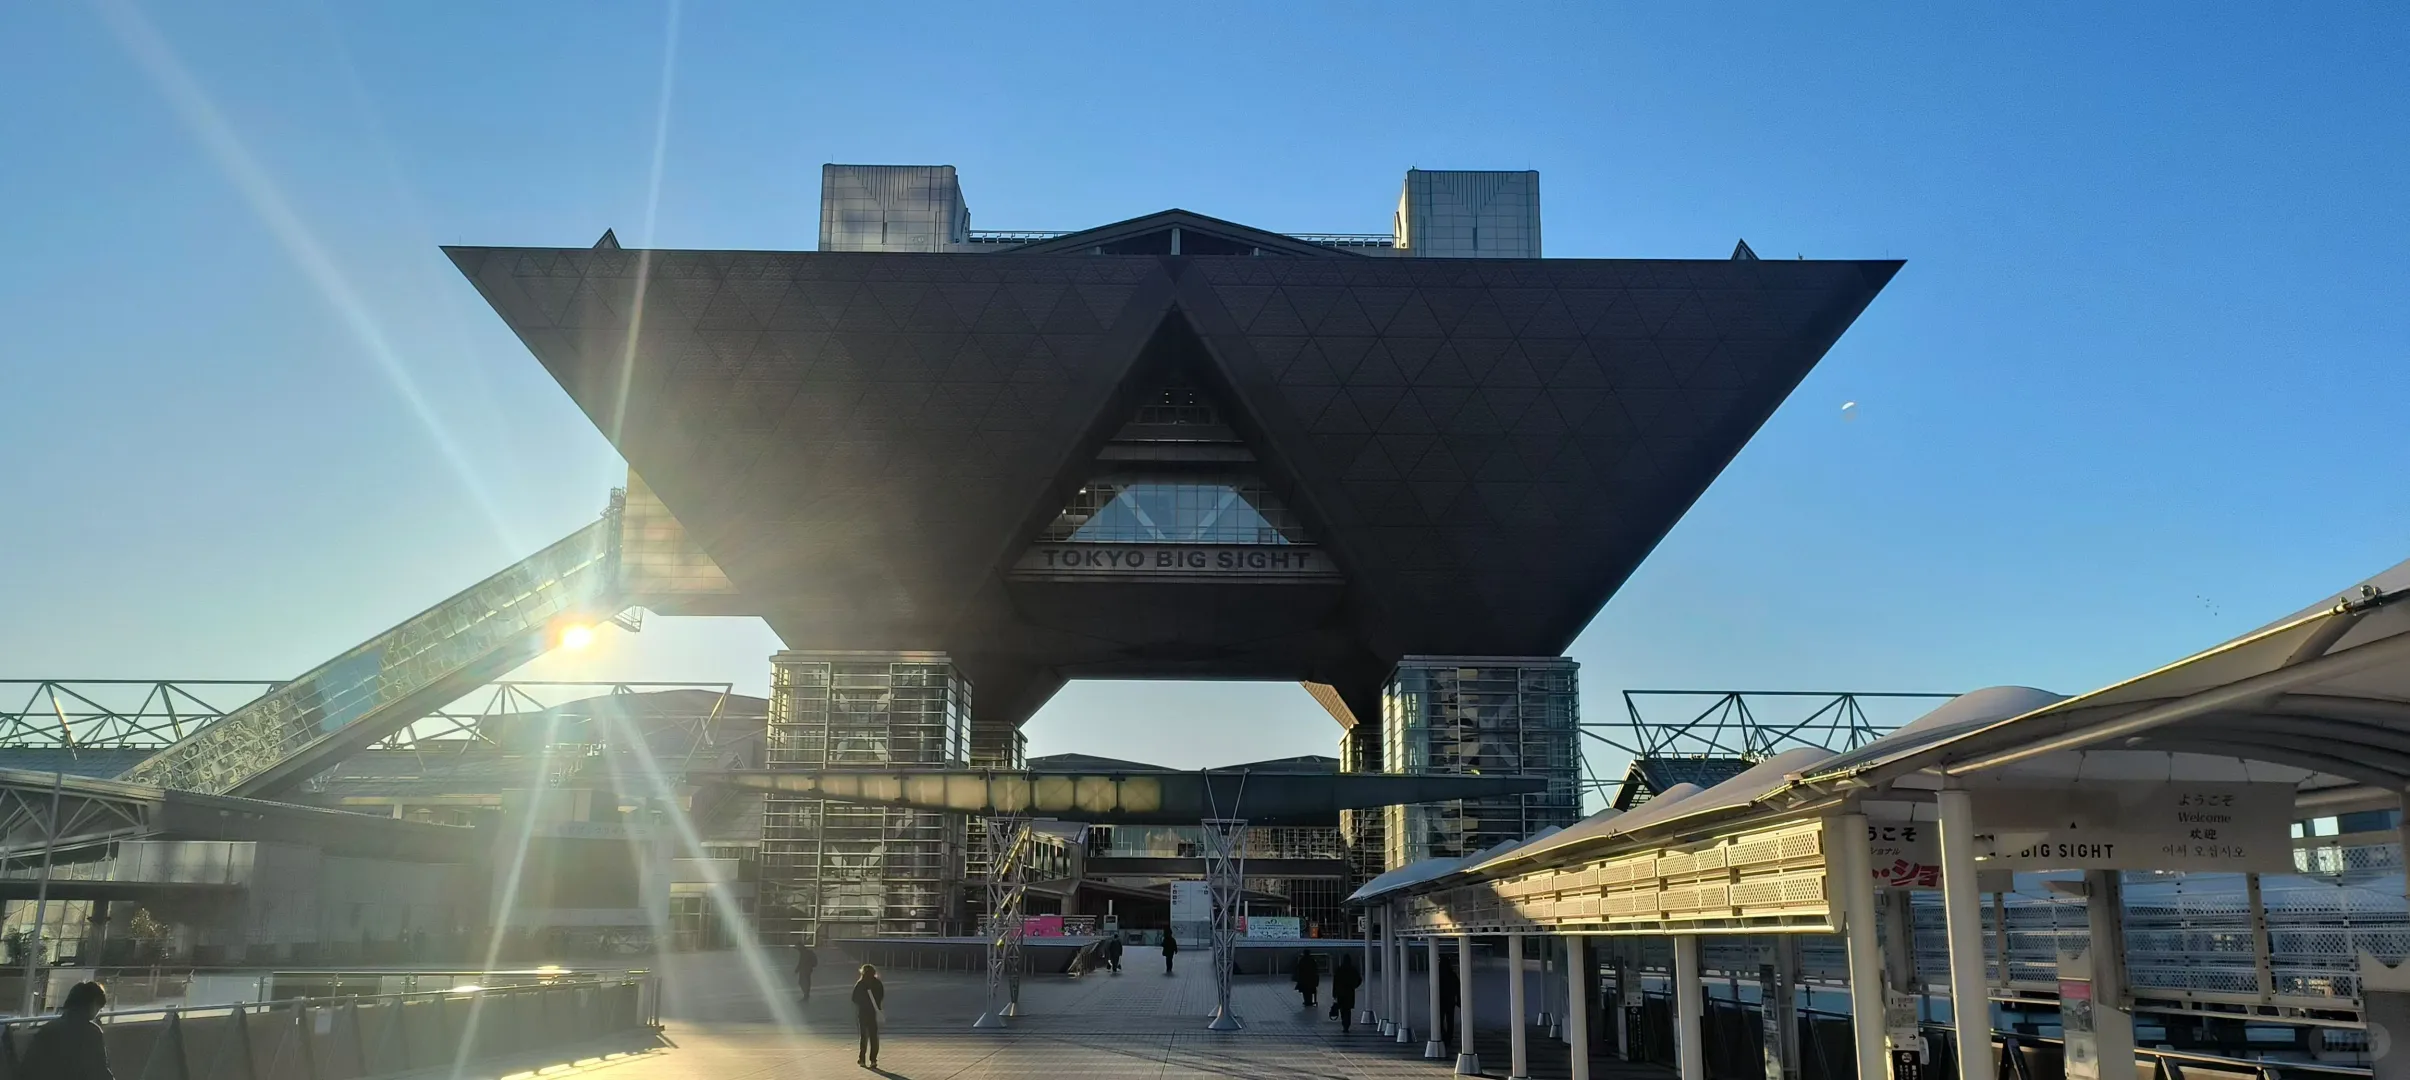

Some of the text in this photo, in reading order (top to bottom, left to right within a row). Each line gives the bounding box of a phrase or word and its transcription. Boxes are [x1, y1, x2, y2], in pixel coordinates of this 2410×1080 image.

[1041, 549, 1311, 569] TOKYO BIG SIGHT
[2178, 793, 2234, 807] ようこそ
[2177, 811, 2232, 824] Welcome
[2189, 827, 2218, 840] 欢迎
[2059, 844, 2114, 858] SIGHT
